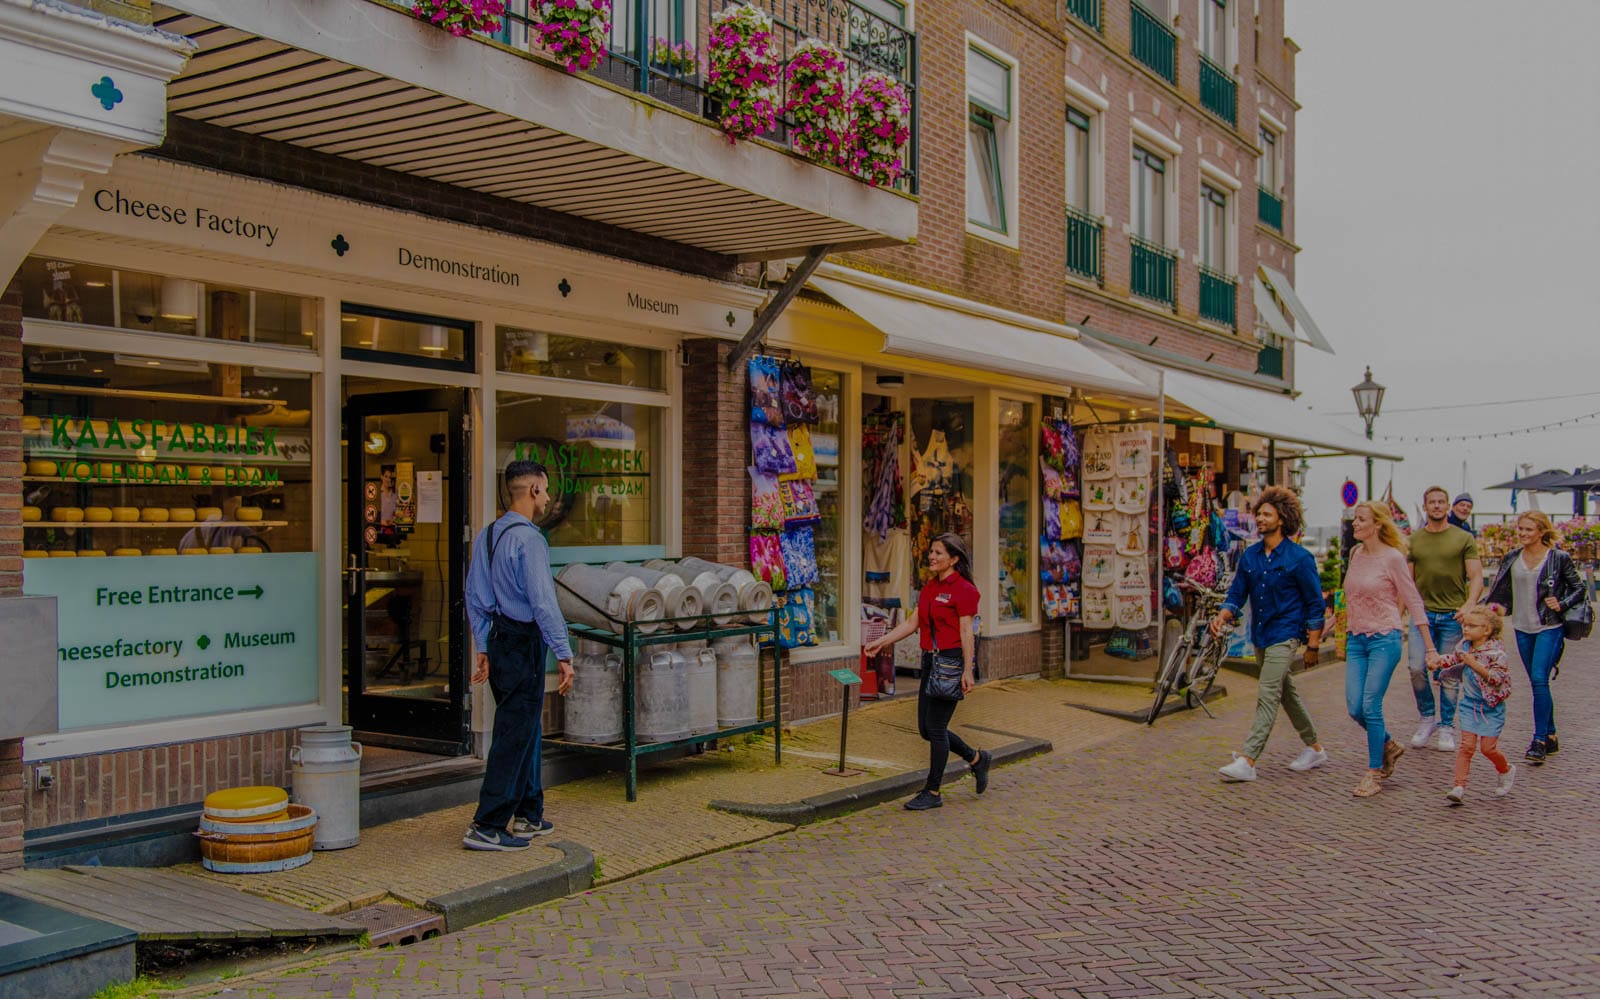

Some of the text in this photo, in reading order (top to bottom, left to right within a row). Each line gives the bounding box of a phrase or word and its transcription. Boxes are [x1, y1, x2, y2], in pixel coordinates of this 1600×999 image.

[94, 189, 279, 247] Cheese Factory
[398, 247, 520, 287] Demonstration
[627, 292, 679, 316] Museum
[52, 414, 280, 457] KAASFABRIEK
[56, 459, 279, 488] VOLENDAM & EDAM
[548, 476, 593, 494] ENDAM
[611, 480, 643, 496] EDAM
[96, 584, 234, 606] Free Entrance
[224, 629, 295, 649] Museum
[106, 661, 244, 689] Demonstration
